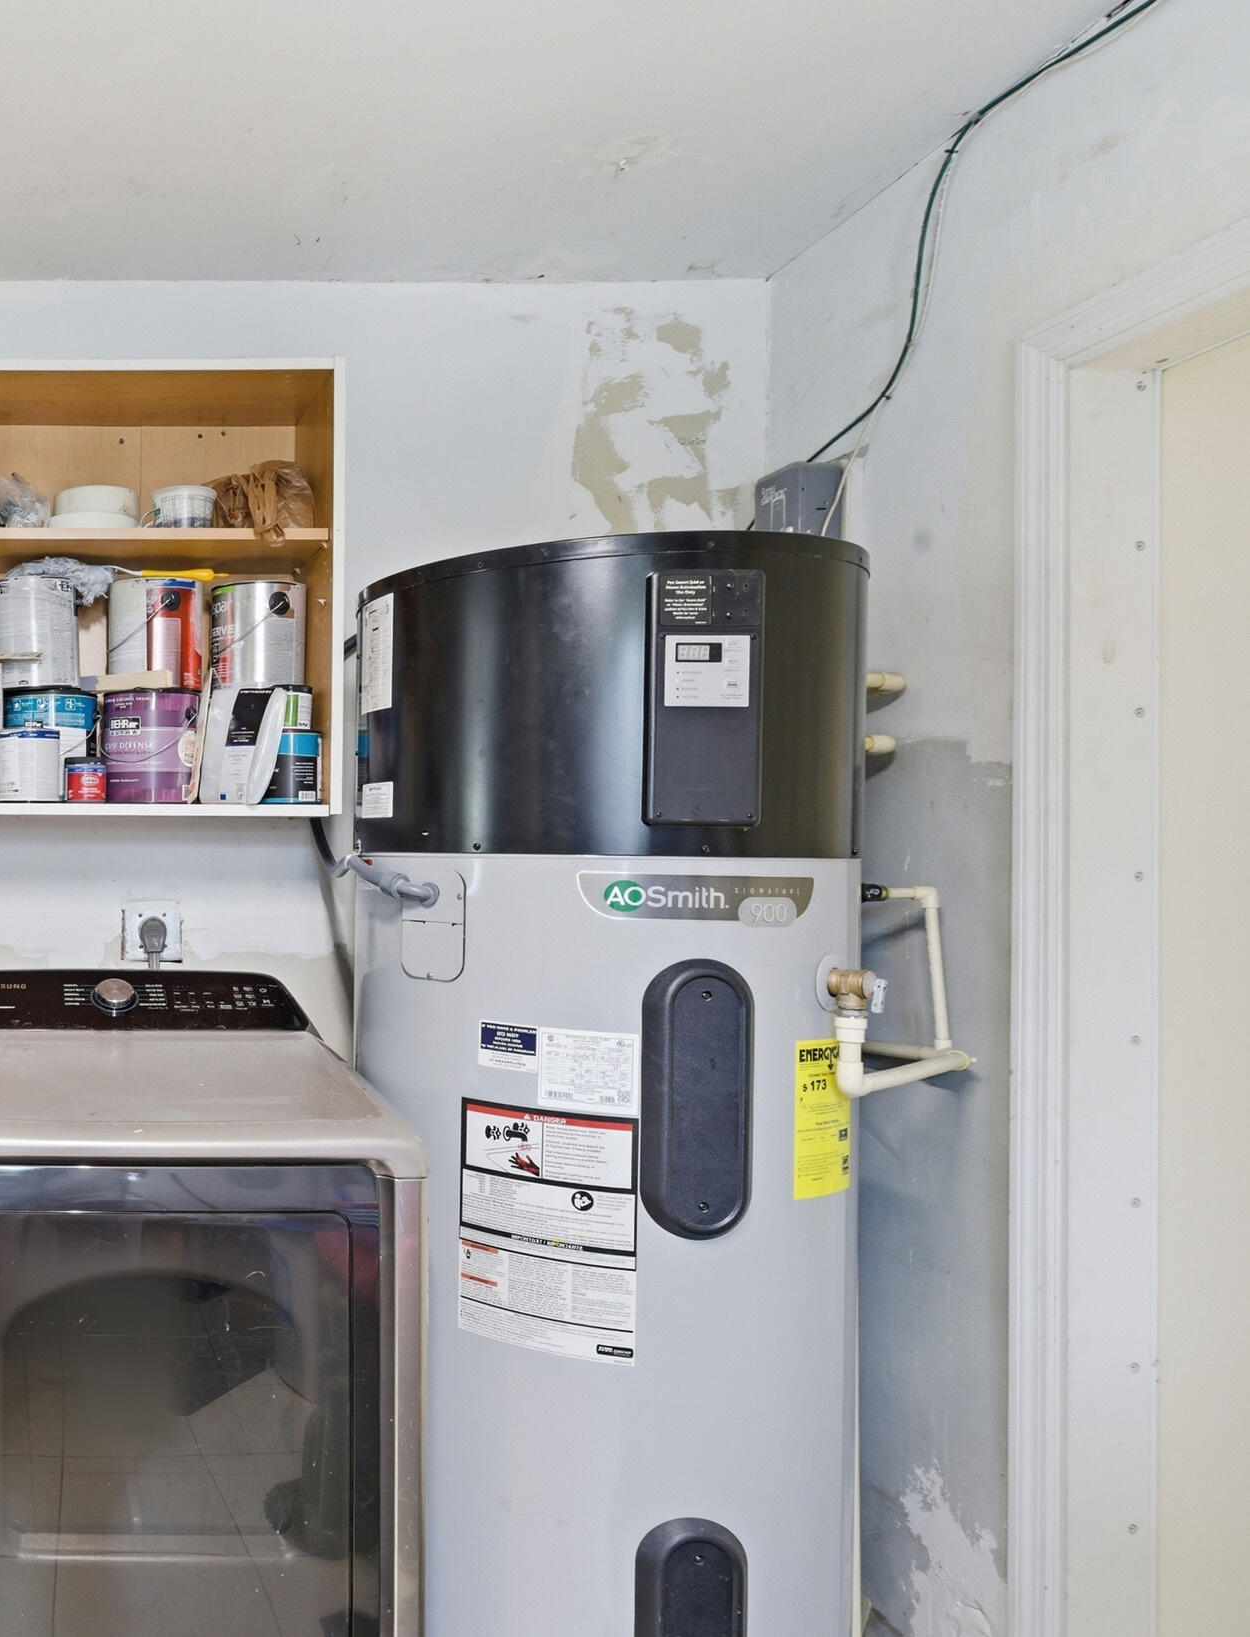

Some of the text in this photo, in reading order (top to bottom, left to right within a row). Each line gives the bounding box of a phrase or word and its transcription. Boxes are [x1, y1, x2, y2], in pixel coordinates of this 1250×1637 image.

[734, 887, 801, 895] SIGNATURE
[750, 903, 788, 923] 900
[810, 1079, 827, 1091] 173
[533, 1114, 567, 1125] DANGER
